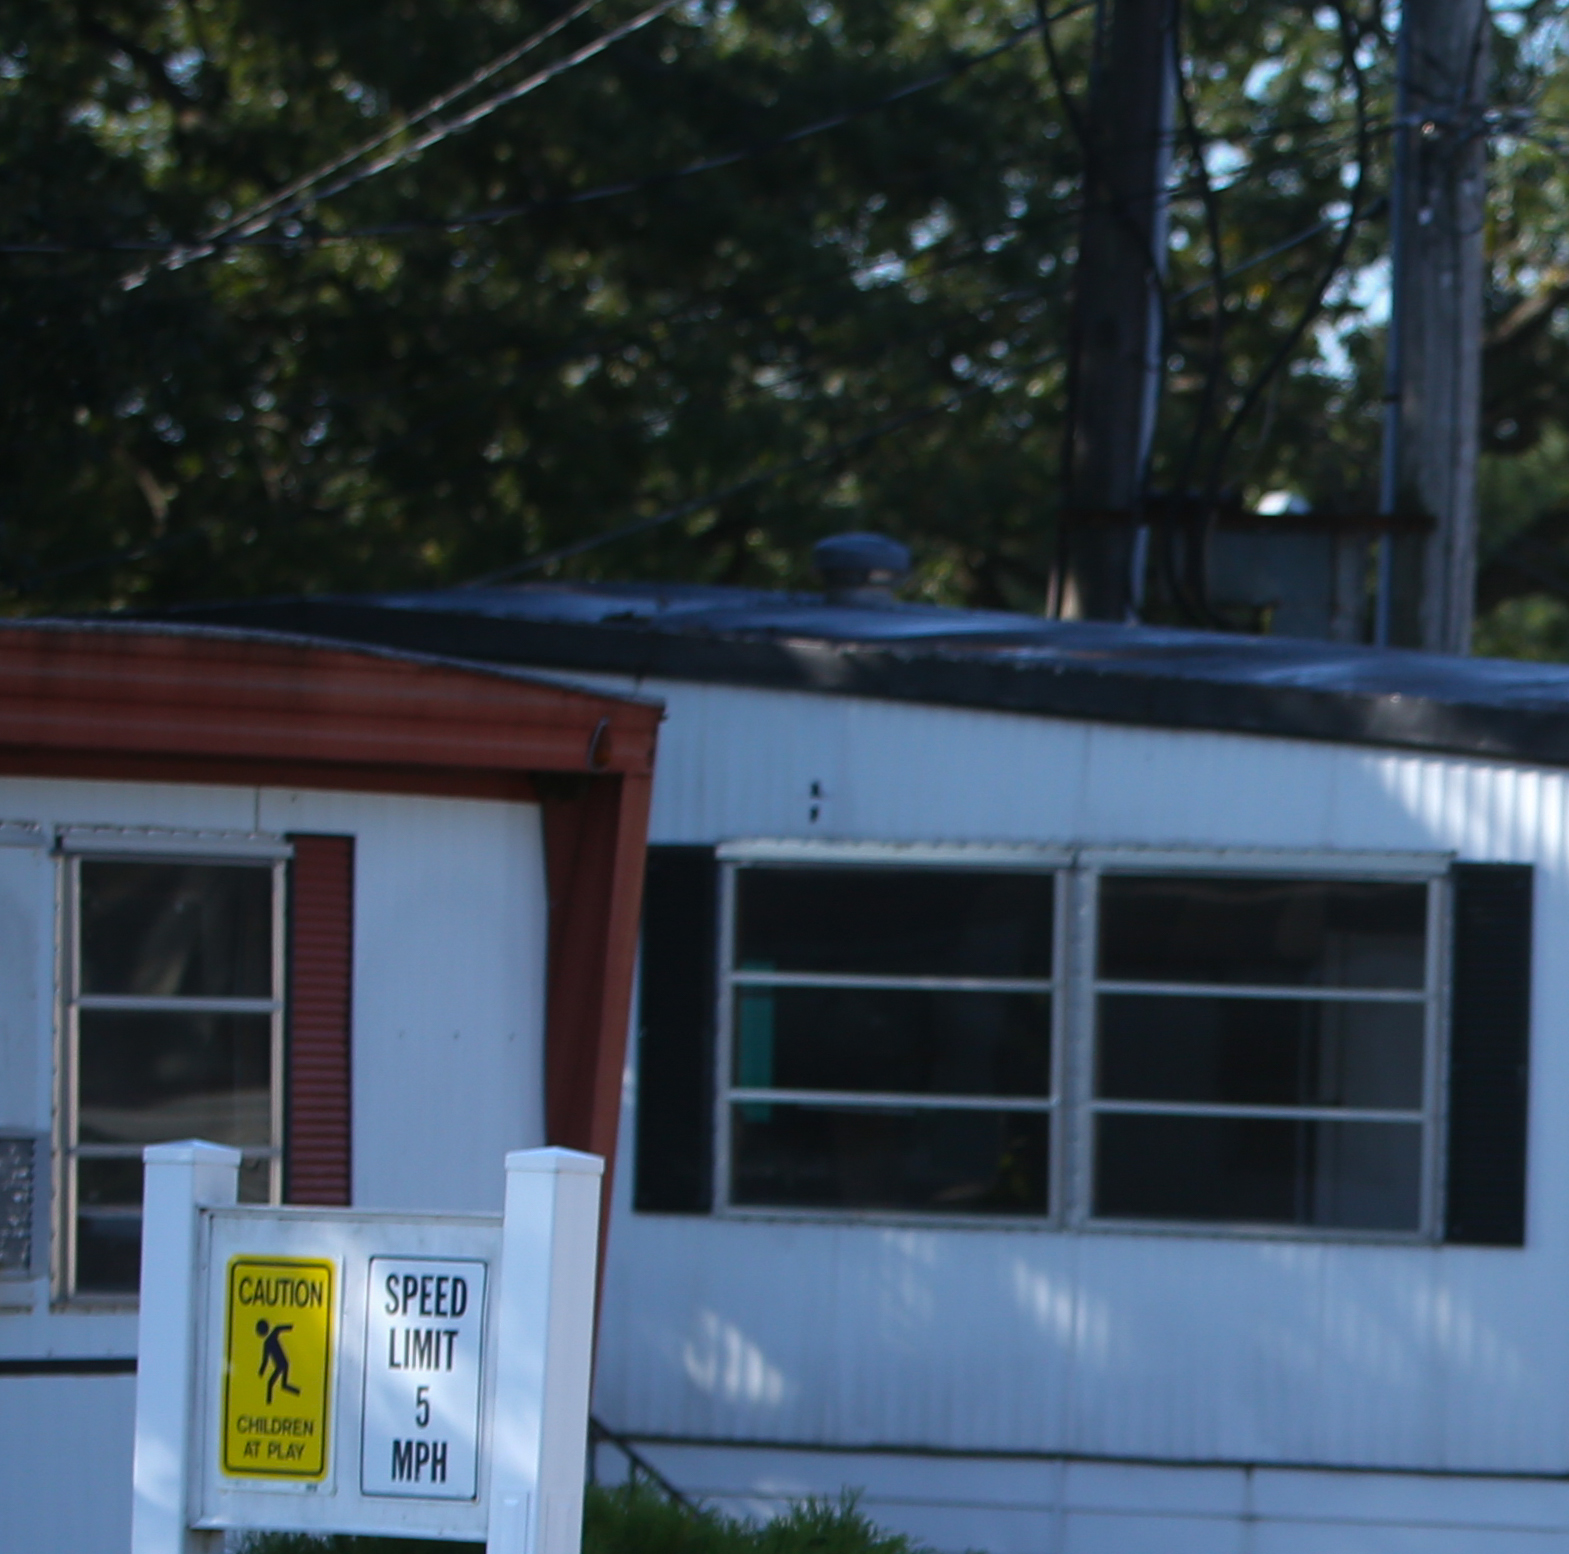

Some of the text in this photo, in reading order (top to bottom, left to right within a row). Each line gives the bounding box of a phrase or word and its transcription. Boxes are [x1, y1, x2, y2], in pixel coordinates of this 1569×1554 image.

[239, 1277, 322, 1308] CAUTION
[386, 1274, 467, 1317] SPEED
[388, 1328, 458, 1371] LIMIT
[236, 1416, 314, 1437] CHILDREN
[416, 1386, 430, 1428] 5
[243, 1441, 305, 1461] AT PLAY
[391, 1439, 448, 1483] MPH
